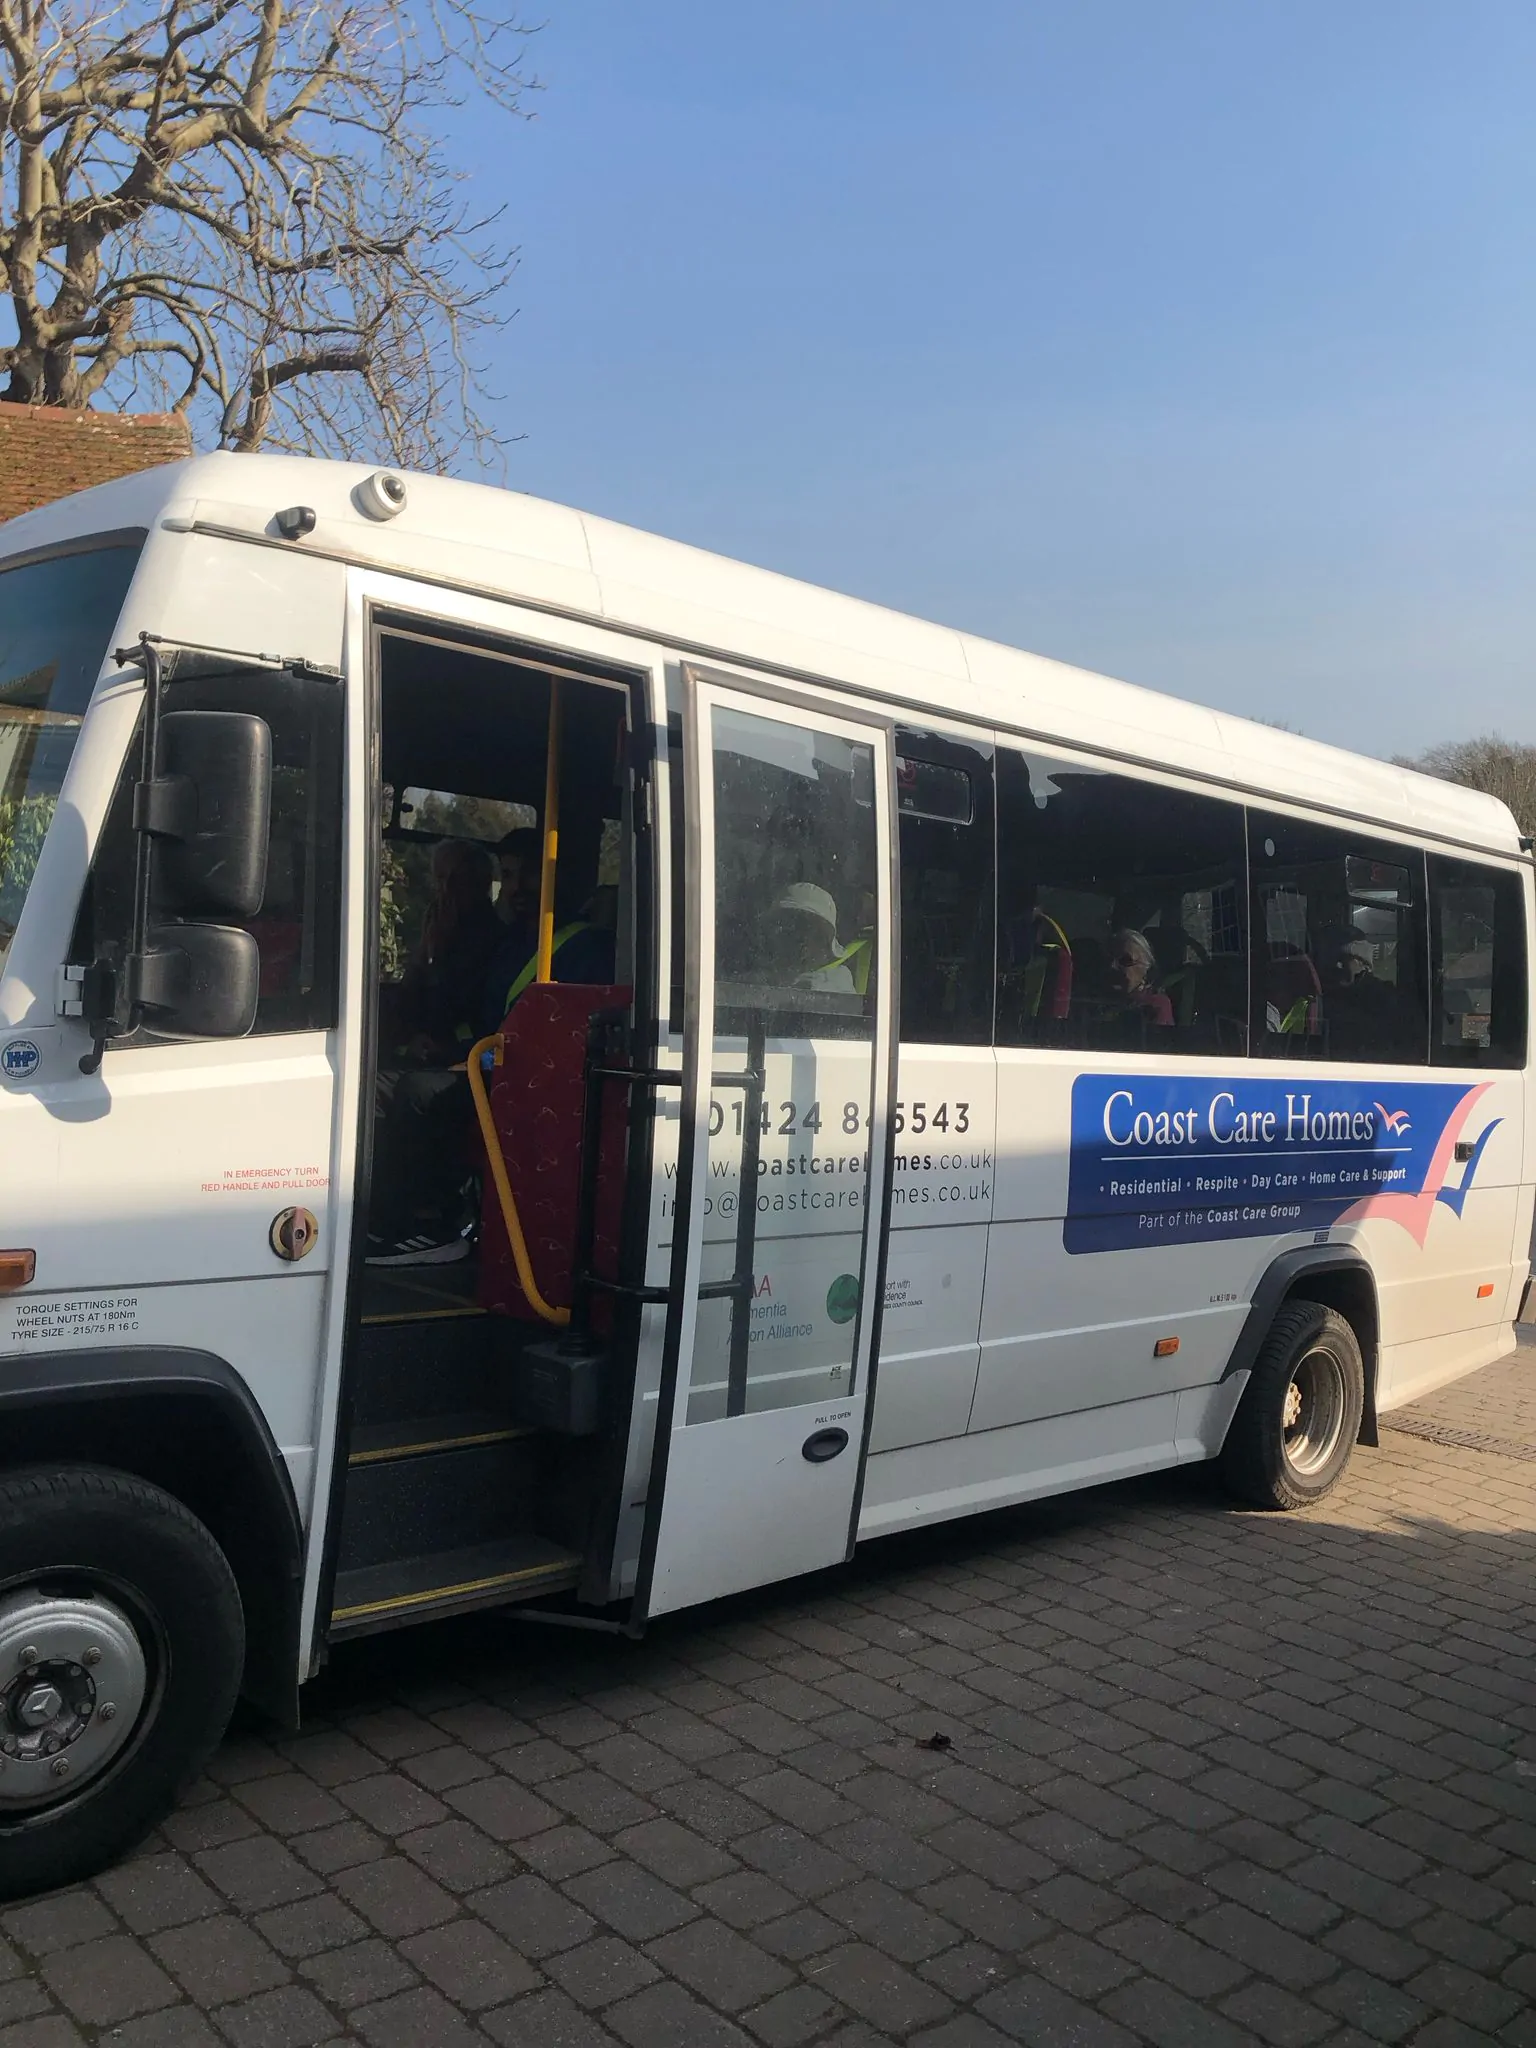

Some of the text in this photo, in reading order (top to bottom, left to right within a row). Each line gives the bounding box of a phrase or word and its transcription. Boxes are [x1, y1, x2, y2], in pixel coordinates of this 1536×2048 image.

[842, 1101, 970, 1135] 85543
[1103, 1090, 1374, 1146] Coast Care Homes
[223, 1167, 319, 1179] IN EMERGENCY TURN
[1110, 1167, 1407, 1196] Residential Respite Day Care Home Care & Support
[201, 1178, 331, 1192] RED HANDLE AND PULL DOOR
[1139, 1205, 1300, 1229] Part of the Coast Care Group
[16, 1298, 138, 1315] TORQUE SETTINGS FOR
[16, 1311, 135, 1327] WHEEL NUTS AT 180Nm
[11, 1330, 38, 1340] TYRE
[41, 1327, 64, 1337] SIZE
[73, 1325, 105, 1335] 215/75
[108, 1324, 115, 1332] R
[118, 1323, 129, 1331] 16
[131, 1321, 139, 1330] C
[767, 1322, 813, 1340] Alliance
[837, 1411, 851, 1419] OPEN
